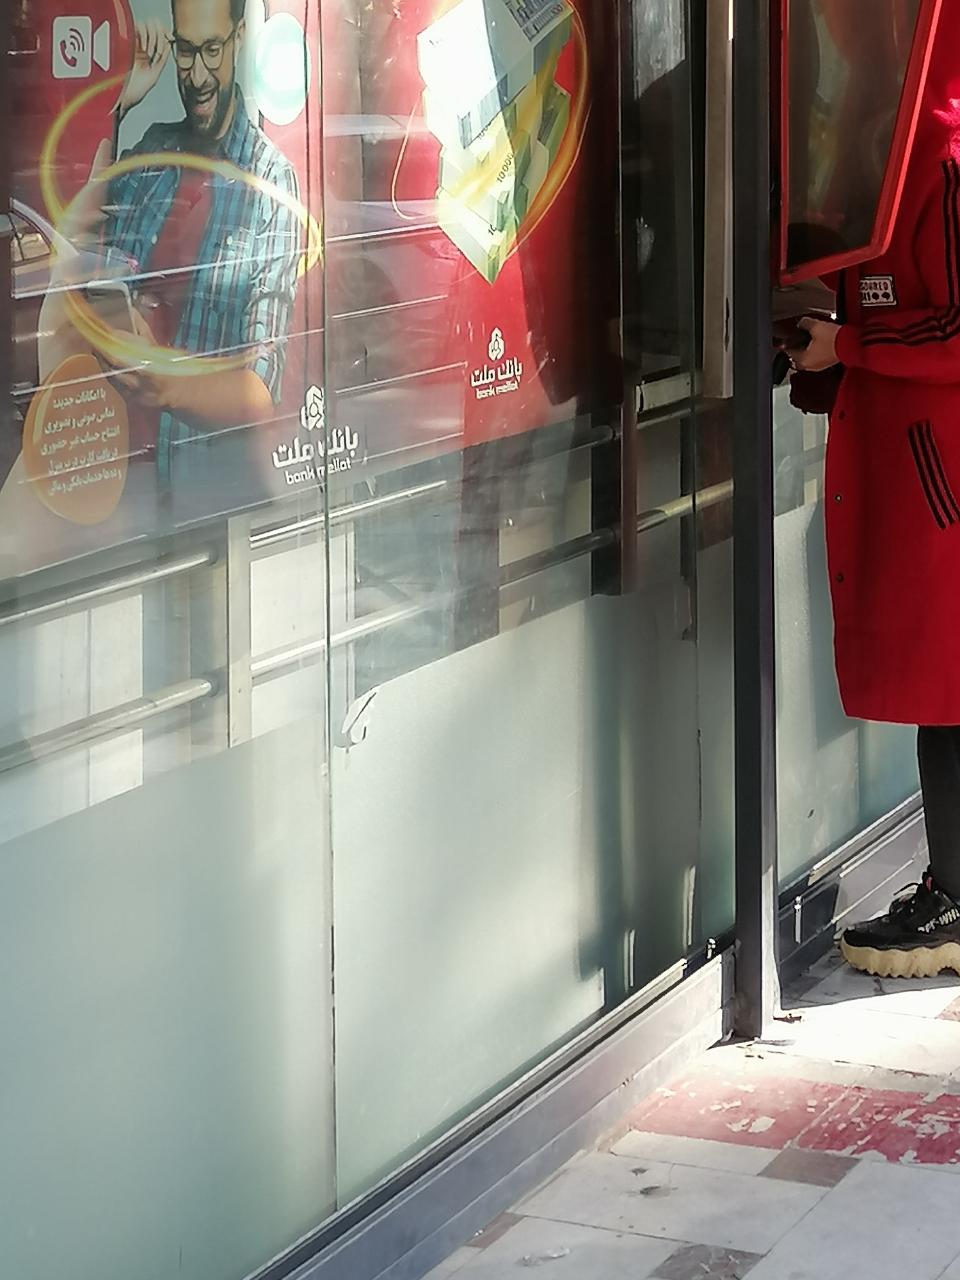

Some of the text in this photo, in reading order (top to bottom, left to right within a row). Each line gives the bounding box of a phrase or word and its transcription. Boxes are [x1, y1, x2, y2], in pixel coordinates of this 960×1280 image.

[471, 356, 522, 387] بانک ملت
[476, 384, 496, 400] bank
[272, 425, 359, 470] بانک ملت
[284, 457, 352, 485] bank mellat
